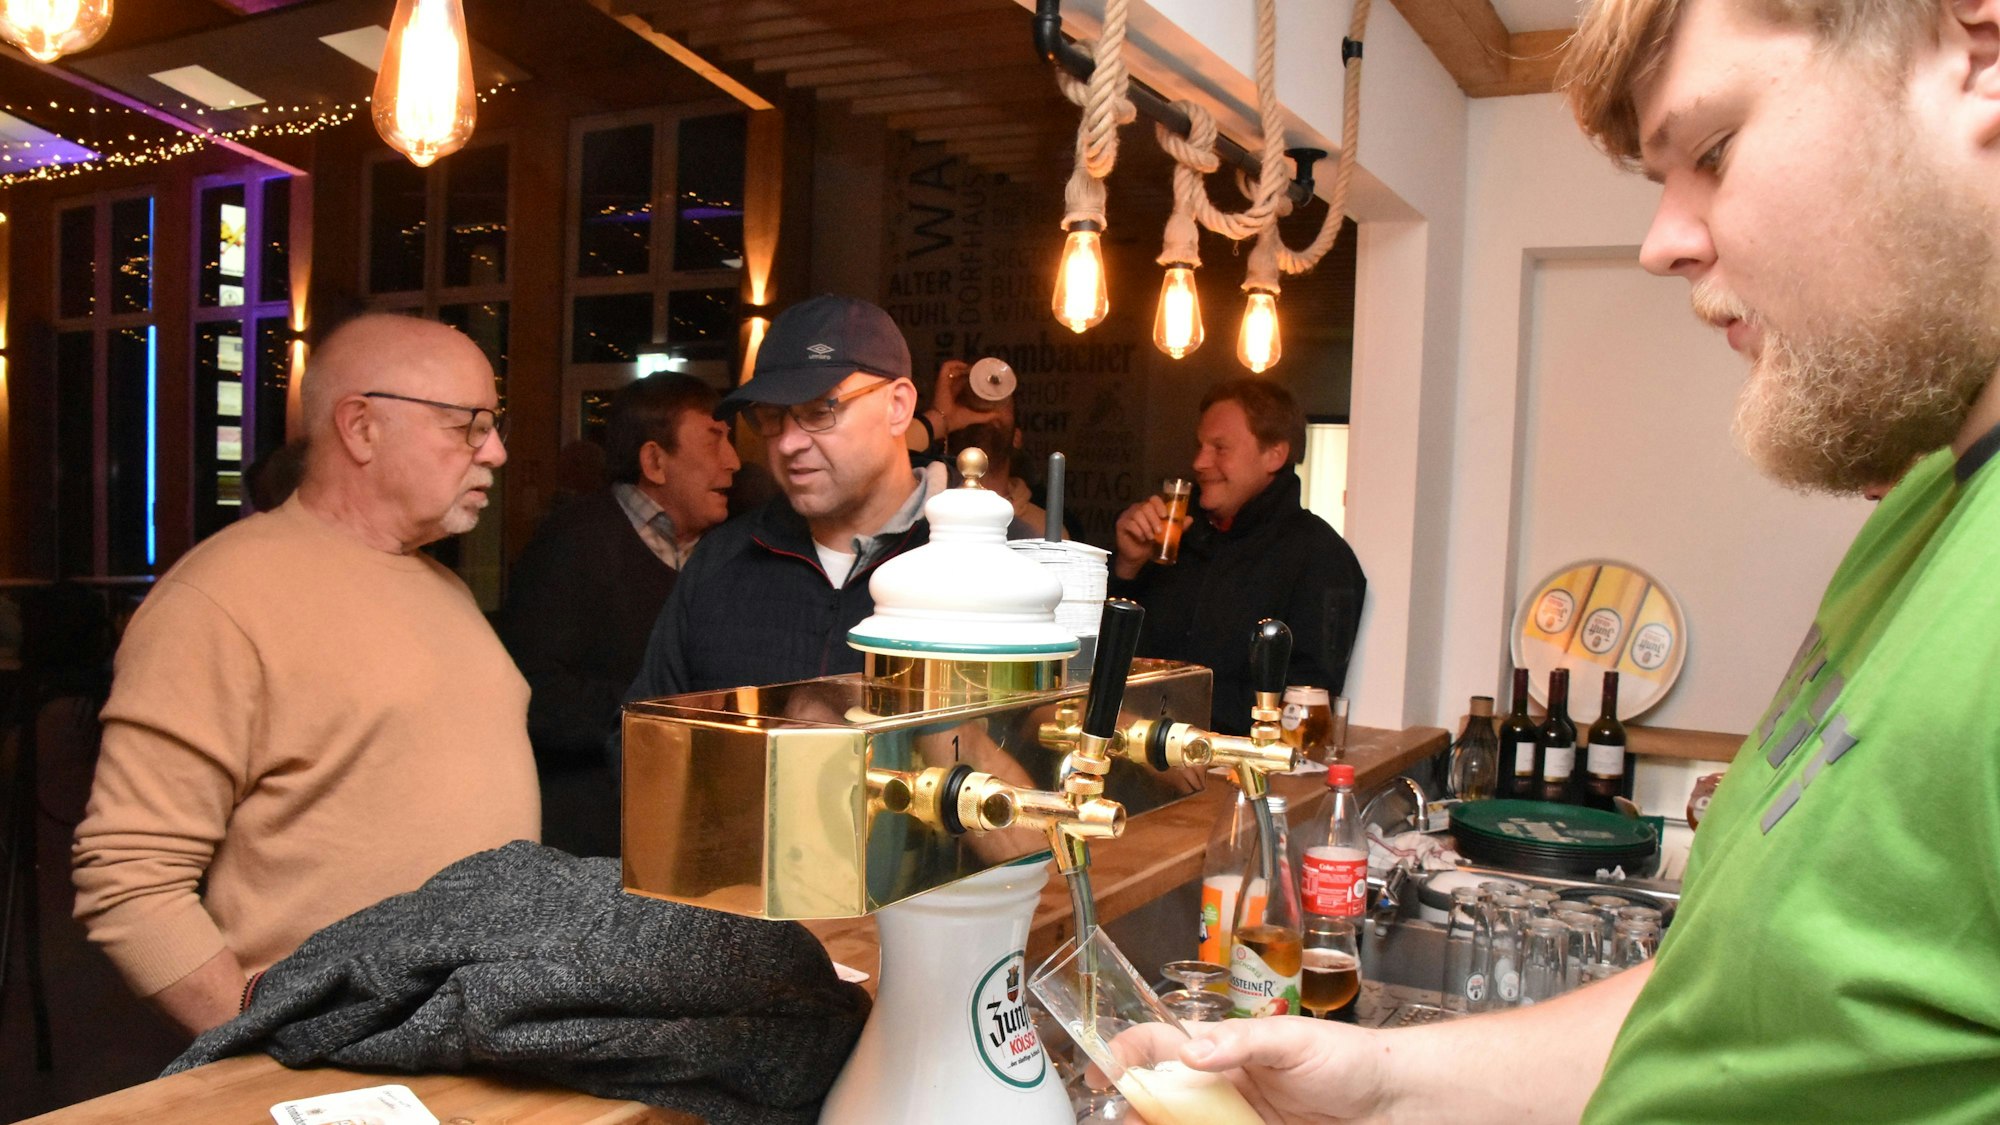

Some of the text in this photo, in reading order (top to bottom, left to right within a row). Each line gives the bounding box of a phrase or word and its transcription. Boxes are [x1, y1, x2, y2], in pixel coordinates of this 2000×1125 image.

[958, 172, 987, 325] DORFHAUS
[889, 270, 952, 298] ALTER
[887, 302, 952, 328] STUHL
[963, 331, 1136, 374] Krombacher
[1160, 695, 1167, 715] 2
[952, 735, 959, 762] 1
